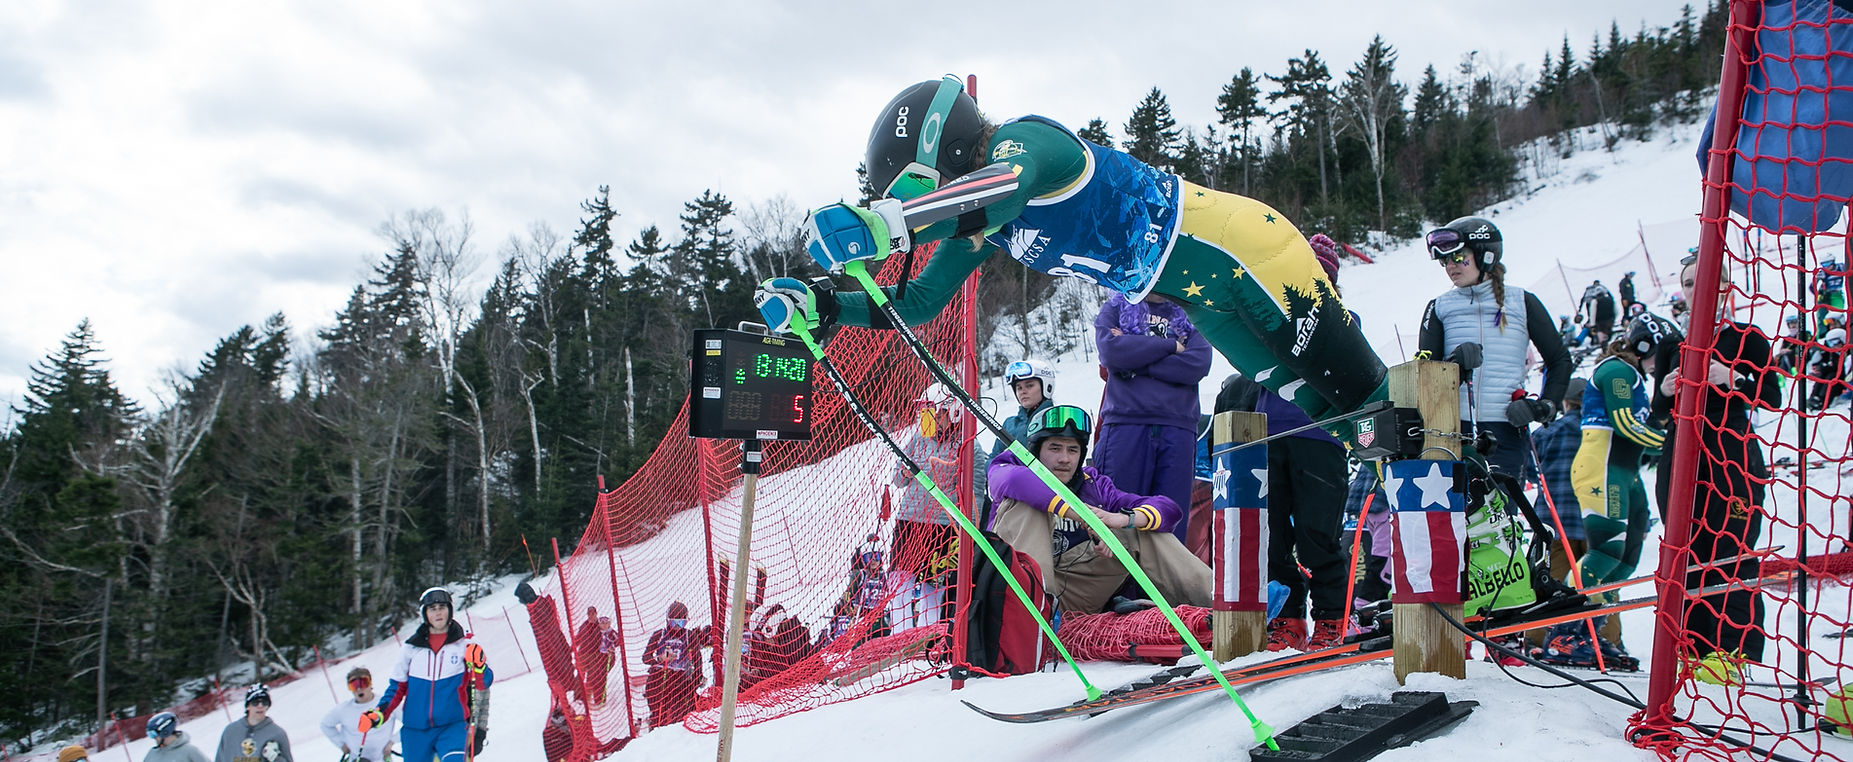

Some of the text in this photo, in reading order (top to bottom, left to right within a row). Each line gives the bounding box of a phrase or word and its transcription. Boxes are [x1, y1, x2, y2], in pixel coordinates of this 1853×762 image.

[1144, 223, 1163, 244] 81
[1047, 253, 1112, 284] 81
[756, 353, 807, 382] 13:14:20
[793, 395, 804, 423] 5
[1469, 561, 1525, 600] ALBELLO
